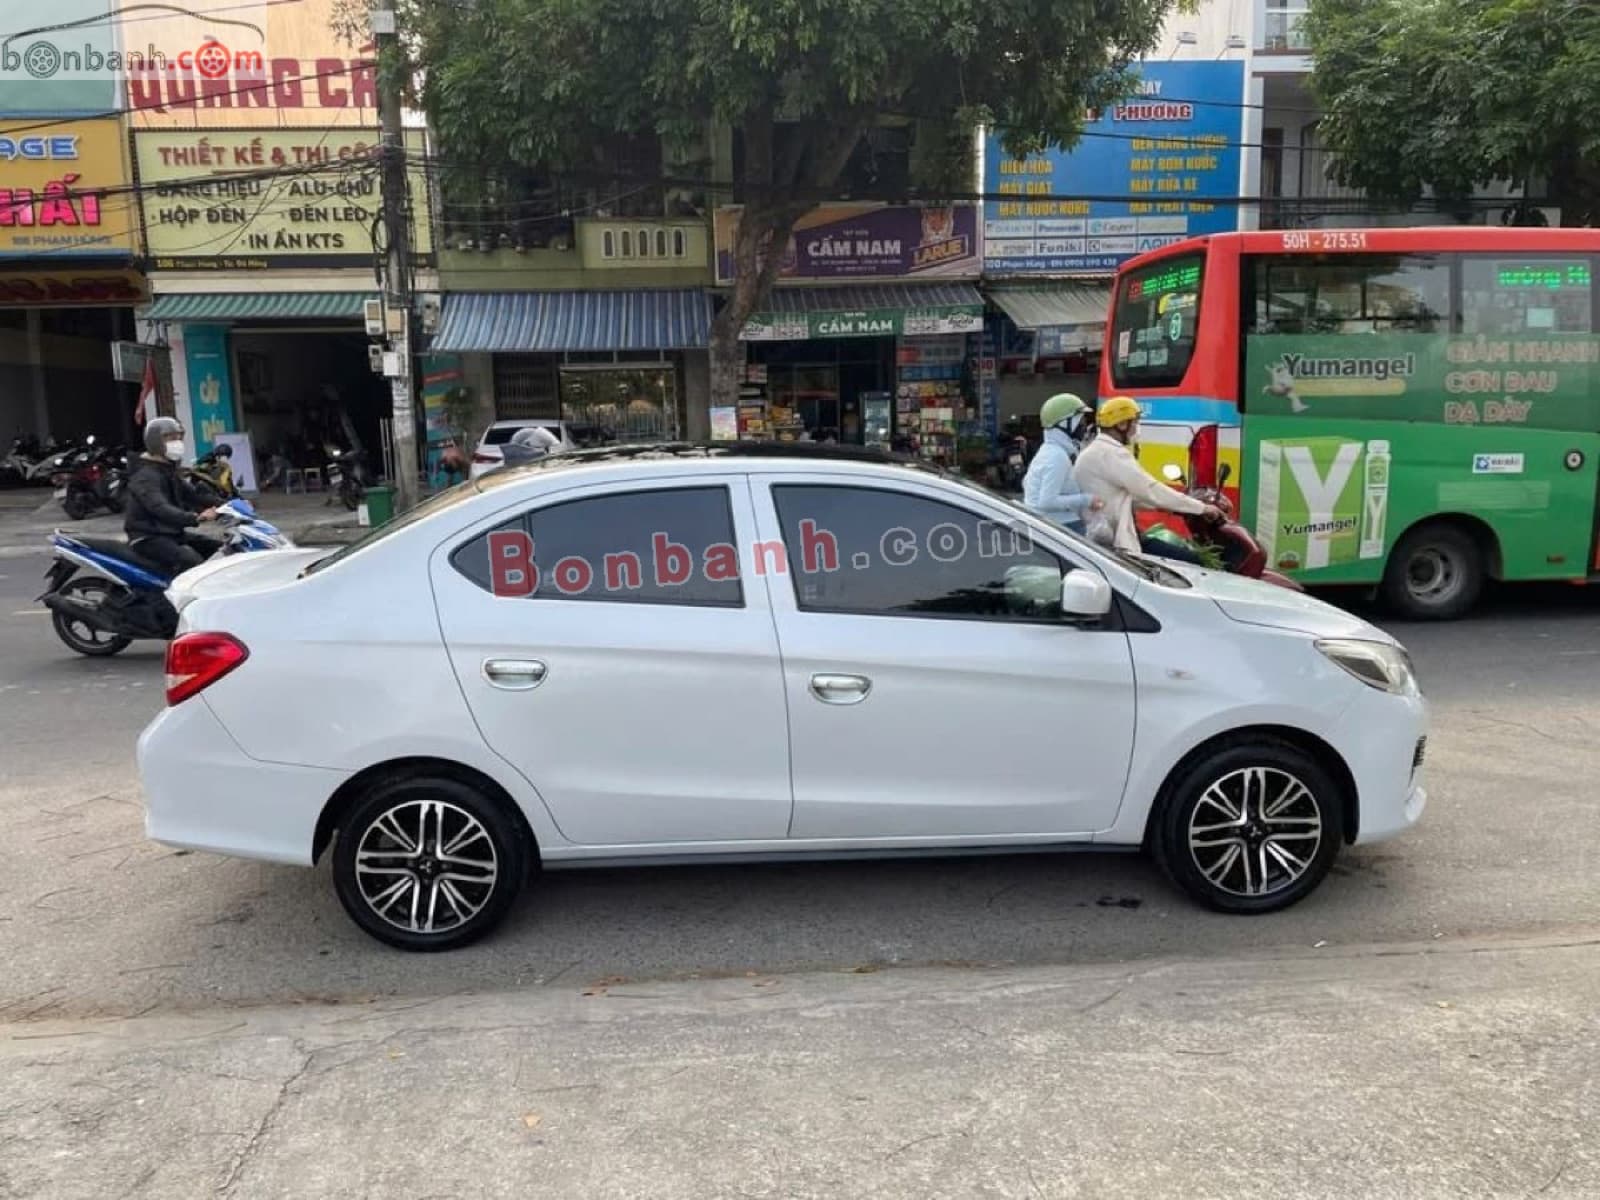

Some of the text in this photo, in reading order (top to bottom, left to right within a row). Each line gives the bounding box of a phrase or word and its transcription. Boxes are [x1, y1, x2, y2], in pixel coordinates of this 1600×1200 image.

[315, 45, 379, 108] CÁ
[158, 137, 226, 166] THIẾT
[234, 137, 265, 165] KẾ
[271, 149, 285, 166] &
[292, 146, 329, 165] THI
[160, 205, 245, 228] HỘP ĐÈN
[290, 205, 329, 223] ĐÈN
[249, 229, 344, 249] IN ẤN KTS
[856, 239, 901, 256] NAM
[1039, 240, 1082, 254] Funiki
[1283, 233, 1309, 248] 50H
[1323, 233, 1366, 248] 275.51
[914, 240, 964, 264] LARUE
[858, 319, 893, 332] NAM
[1282, 353, 1414, 381] Yumangel
[1283, 516, 1356, 536] Yumangel
